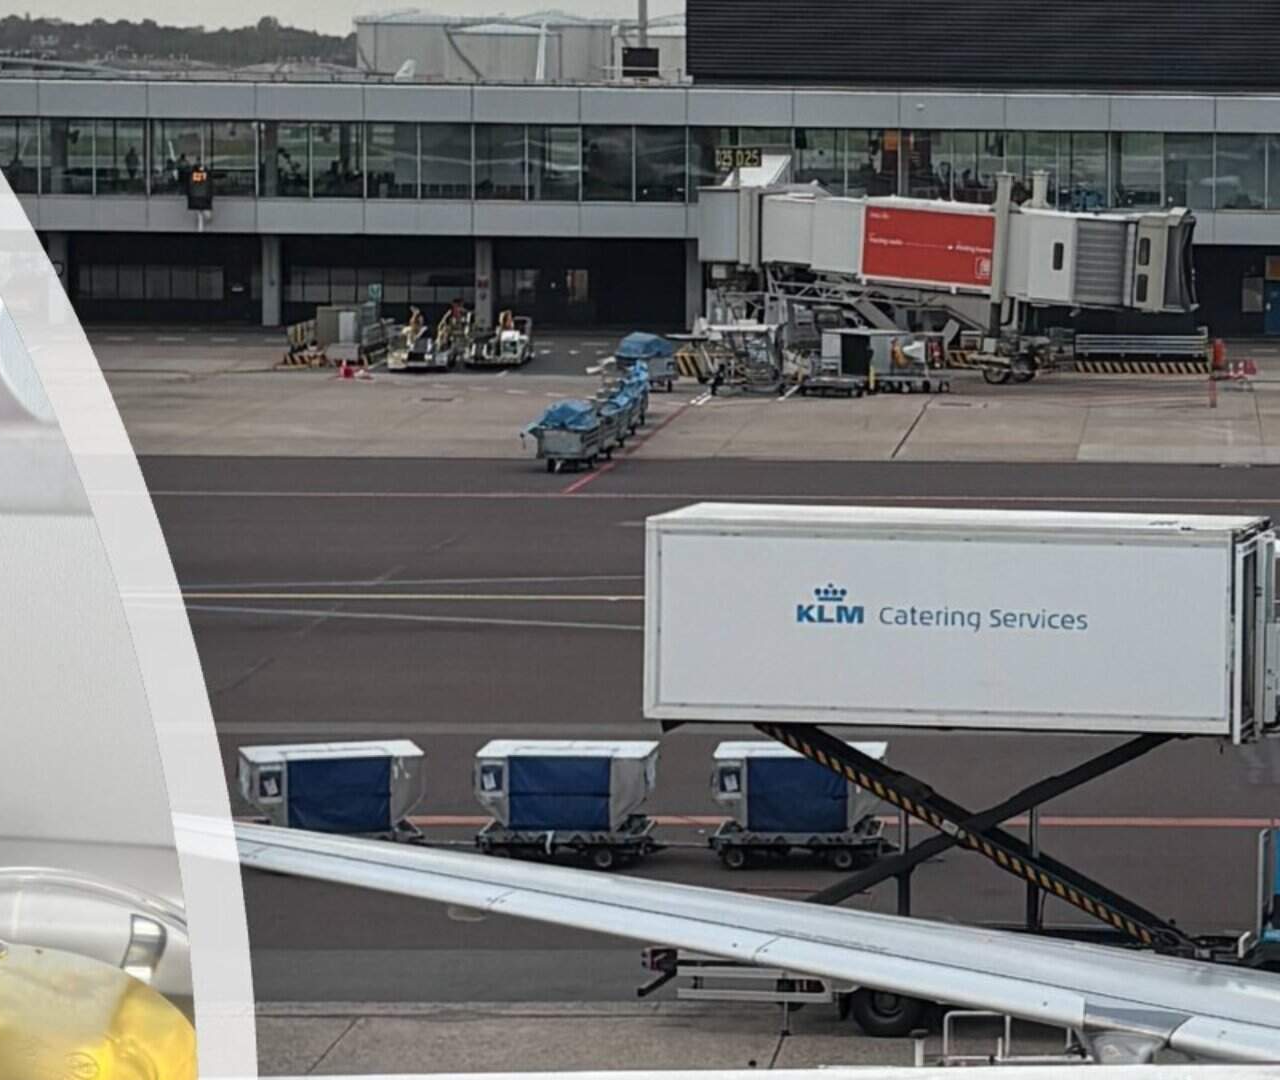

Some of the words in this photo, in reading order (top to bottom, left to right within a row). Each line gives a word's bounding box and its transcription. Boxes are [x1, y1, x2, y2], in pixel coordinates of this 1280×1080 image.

[796, 604, 865, 625] KLM
[878, 605, 981, 632] Catering
[988, 607, 1090, 631] Services
